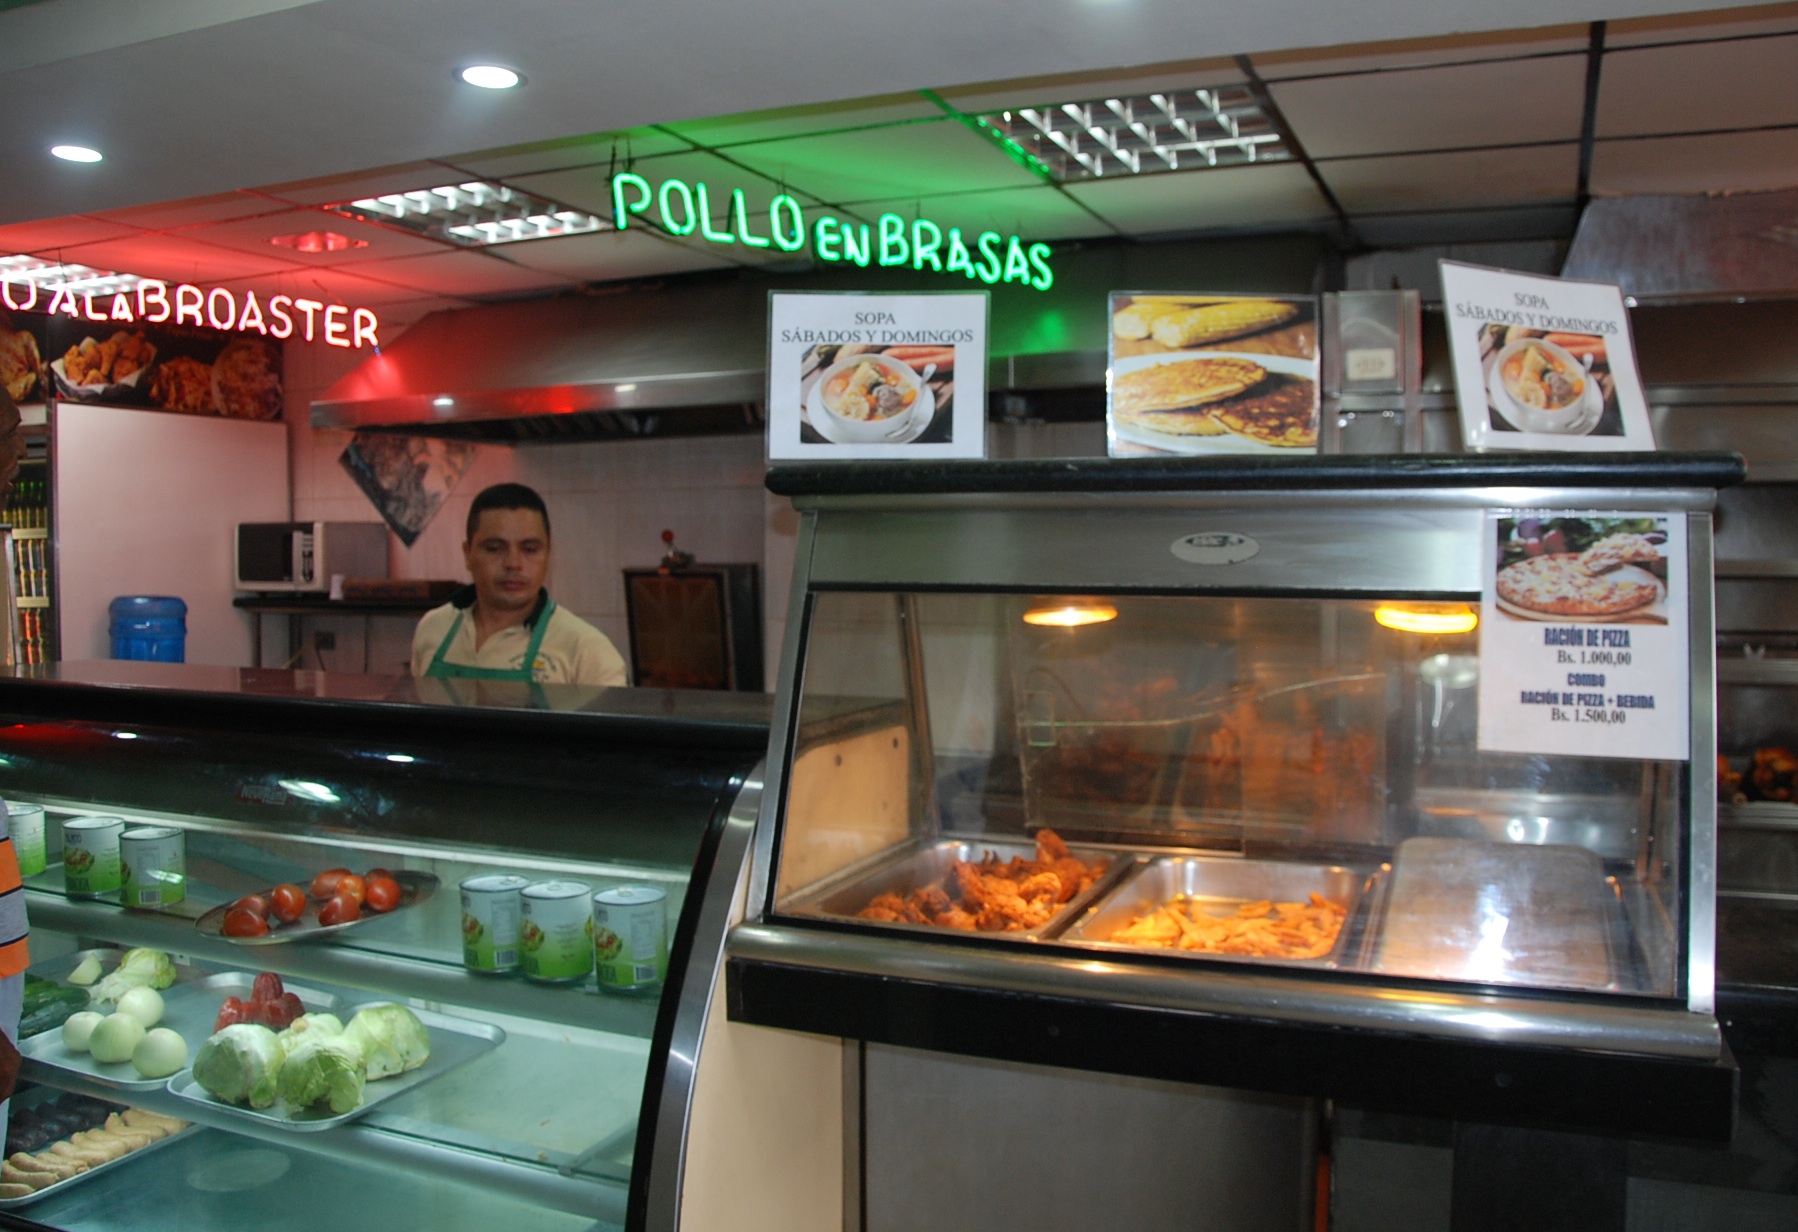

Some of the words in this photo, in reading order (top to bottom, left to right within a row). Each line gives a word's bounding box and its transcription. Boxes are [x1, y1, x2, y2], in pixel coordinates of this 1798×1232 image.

[612, 172, 805, 252] POLLO
[816, 216, 870, 267] EN
[878, 212, 1054, 291] BRASAS
[1514, 292, 1549, 309] SOPA
[137, 278, 379, 348] BROASTER
[854, 312, 896, 325] SOPA
[1456, 303, 1524, 325] SÁBADOS
[1527, 313, 1538, 327] Y
[1539, 316, 1618, 335] DOMINGOS
[781, 327, 861, 343] SÁBADOS
[866, 330, 877, 342] Y
[881, 329, 973, 343] DOMINGOS
[1544, 625, 1584, 646] RACIÓN
[1587, 629, 1599, 647] DE
[1602, 629, 1630, 648] PIZZA
[1557, 650, 1576, 664] Bs.
[1581, 652, 1632, 666] 1.000,00
[1567, 673, 1605, 687] COMBO
[1521, 689, 1559, 706] RACIÓN
[1562, 691, 1574, 706] DE
[1577, 693, 1605, 707] PIZZA
[1617, 695, 1655, 709] BEBIDA
[1551, 708, 1570, 722] Bs.
[1575, 709, 1626, 724] 1.500,00
